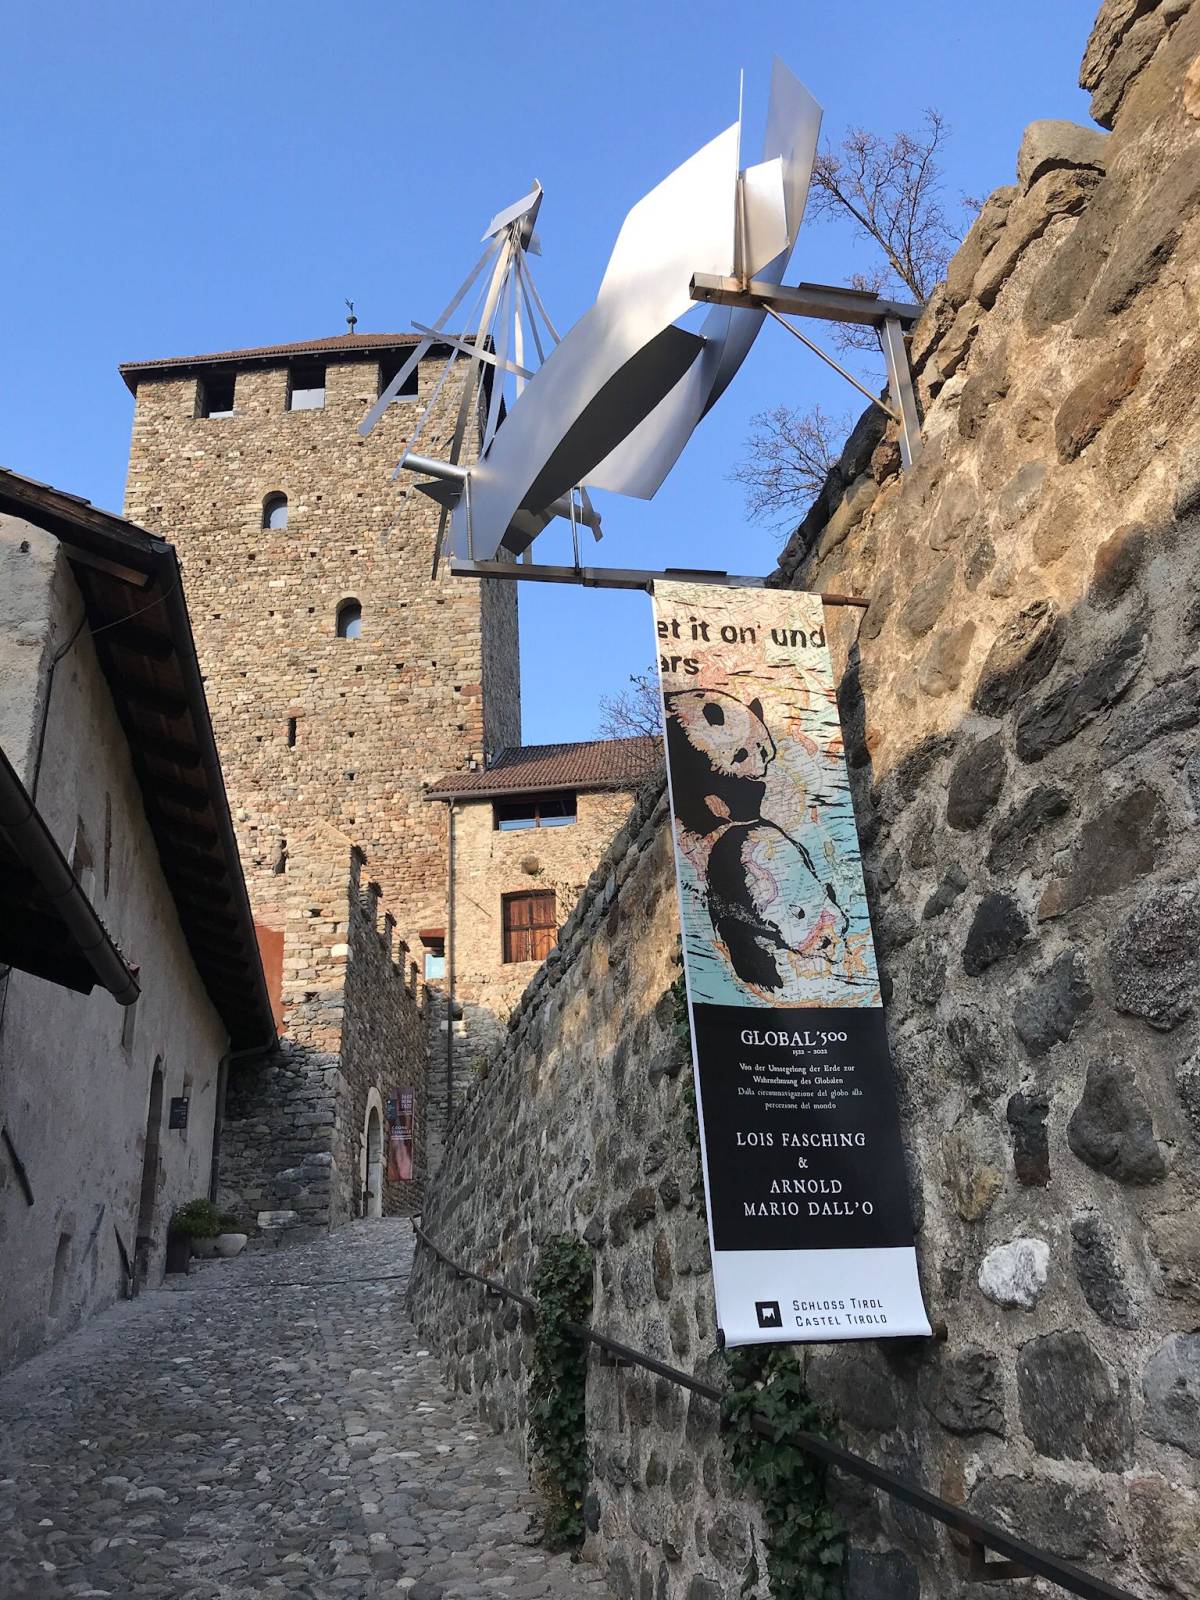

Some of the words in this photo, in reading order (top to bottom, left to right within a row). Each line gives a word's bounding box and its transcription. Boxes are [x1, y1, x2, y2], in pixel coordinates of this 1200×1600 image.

[687, 616, 711, 642] it
[771, 625, 826, 648] und
[739, 1062, 752, 1071] Von
[754, 1064, 766, 1072] der
[823, 1064, 841, 1072] Erde
[753, 1075, 798, 1087] Wahrnehmung
[800, 1077, 812, 1085] des
[814, 1077, 844, 1085] Globalen
[738, 1087, 755, 1096] Dalla
[817, 1089, 828, 1097] del
[830, 1089, 849, 1099] globo
[852, 1088, 863, 1096] alla
[765, 1102, 798, 1111] percezione
[813, 1102, 837, 1110] mondo
[736, 1132, 774, 1146] LOIS
[782, 1132, 866, 1147] FASCHING
[797, 1156, 809, 1169] &
[770, 1179, 843, 1194] ARNOLD
[743, 1201, 800, 1216] MARIO
[808, 1201, 874, 1216] DALL'O
